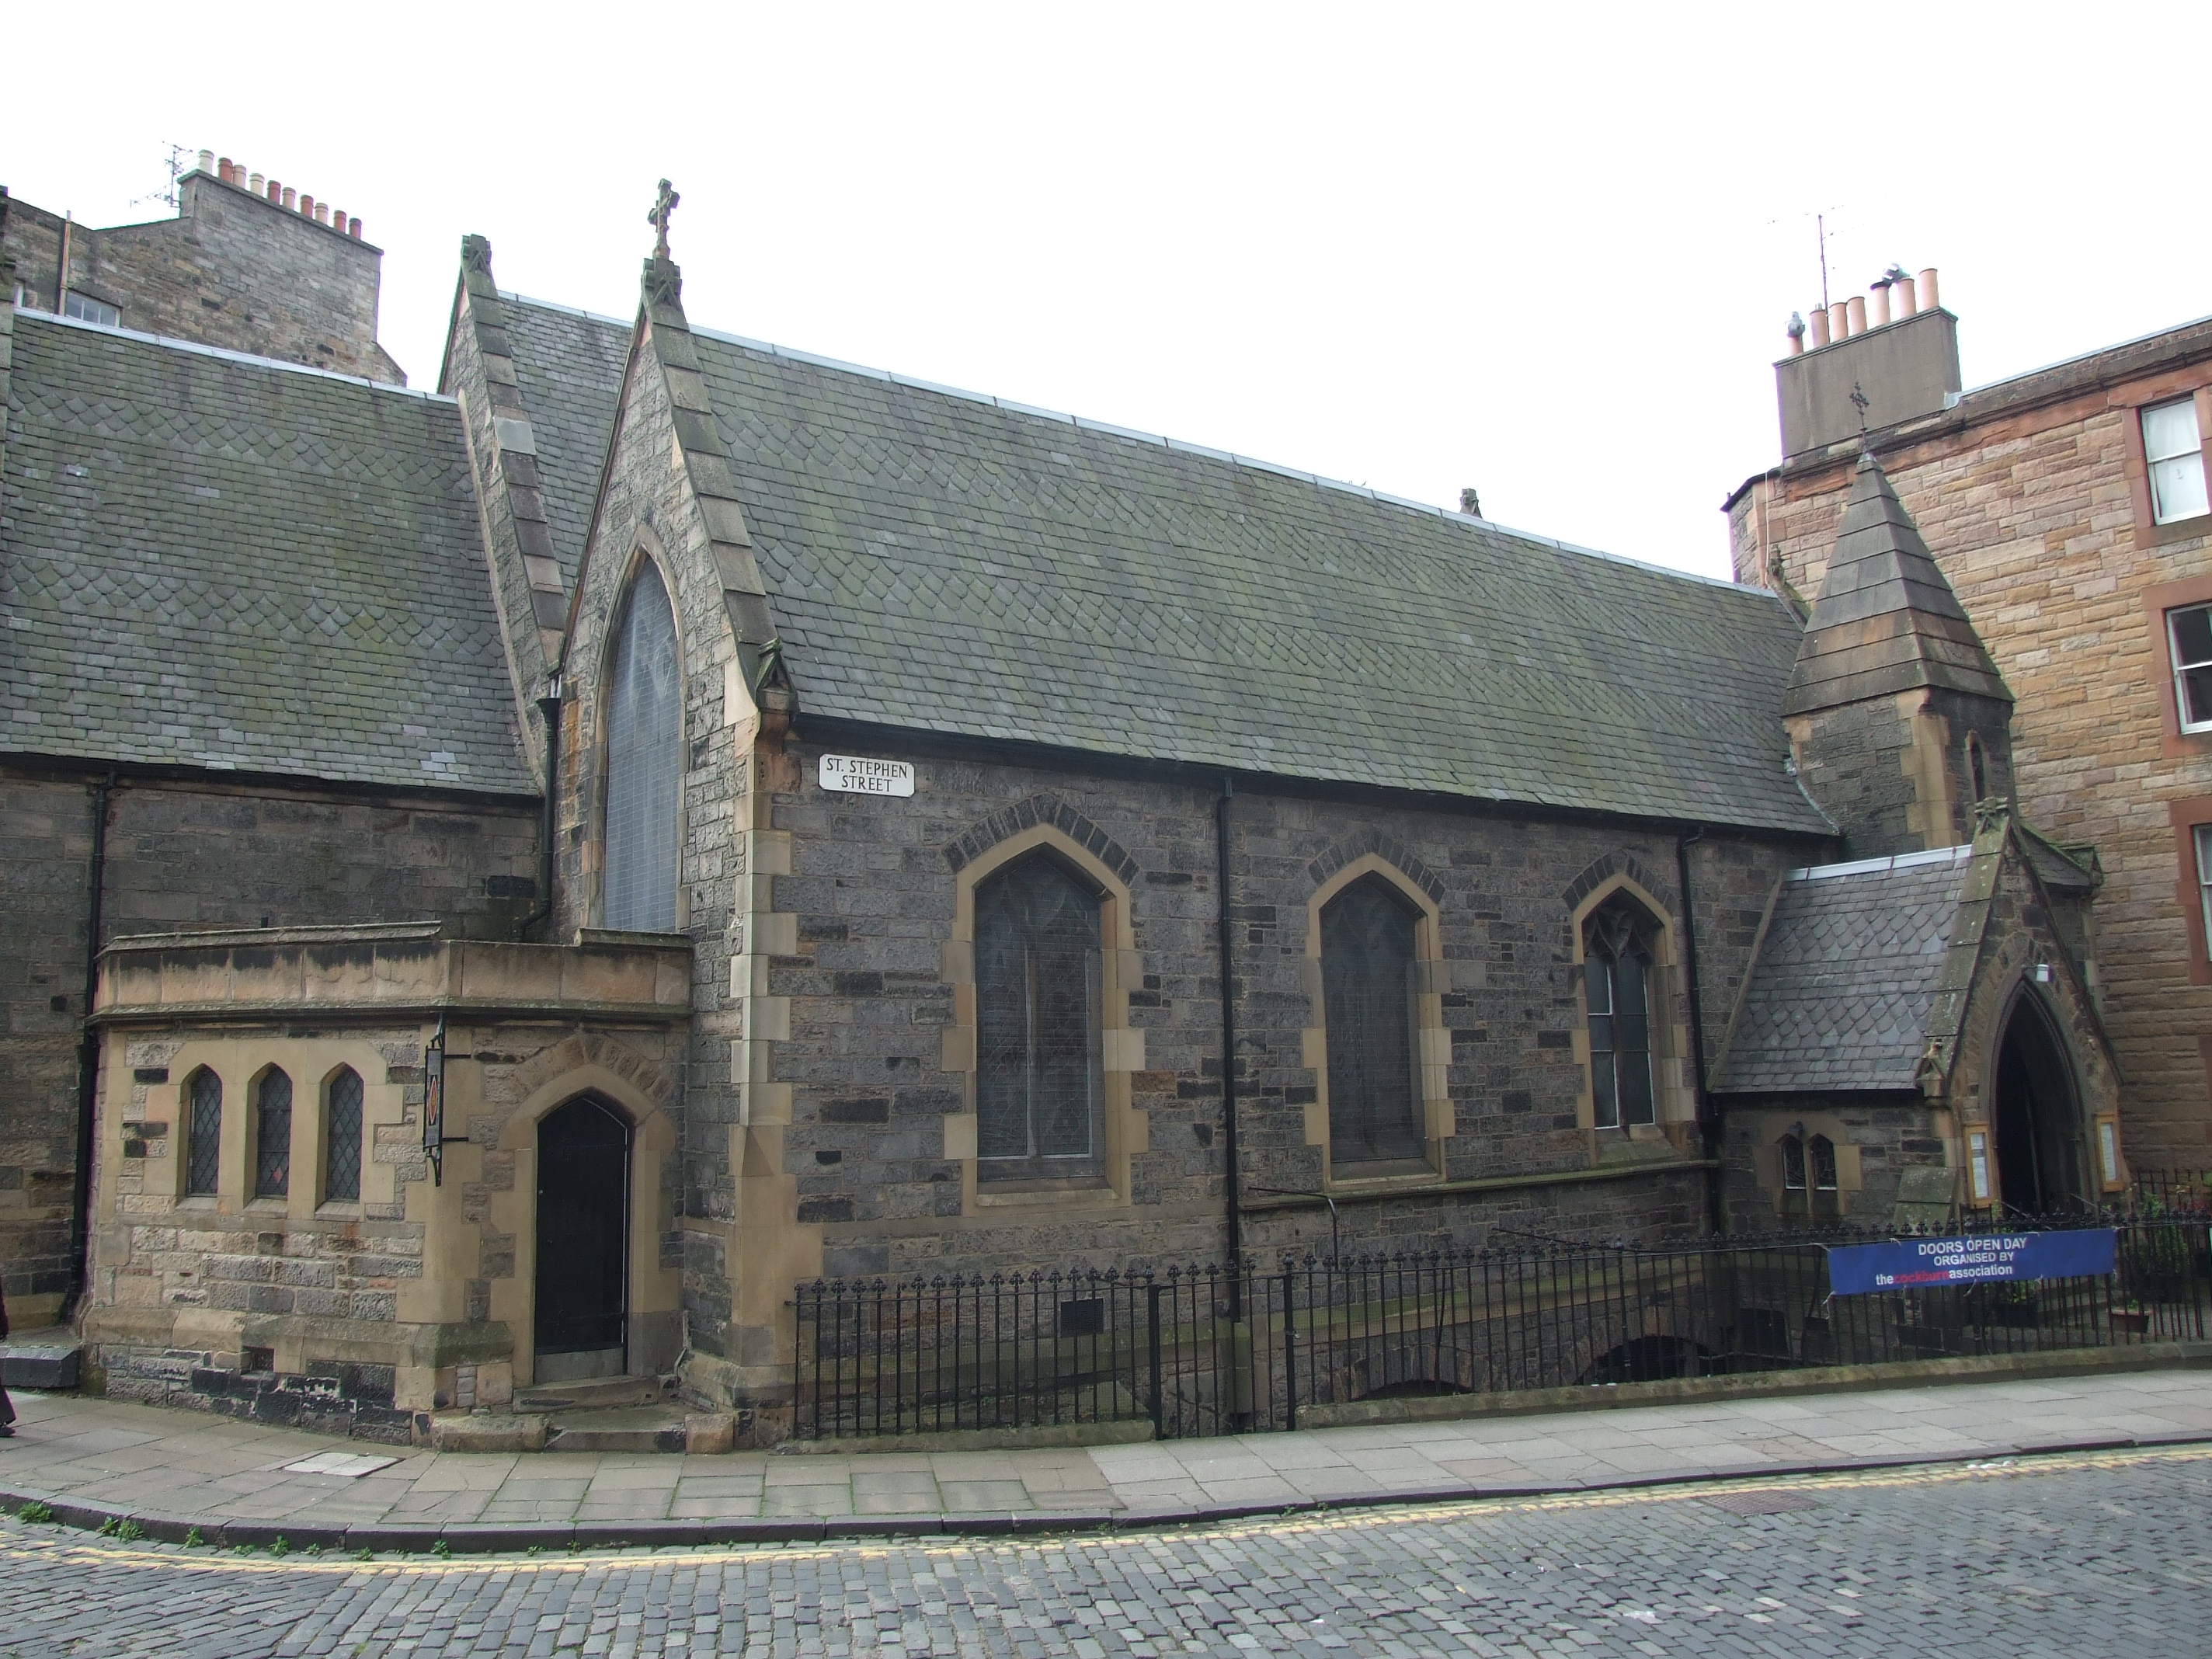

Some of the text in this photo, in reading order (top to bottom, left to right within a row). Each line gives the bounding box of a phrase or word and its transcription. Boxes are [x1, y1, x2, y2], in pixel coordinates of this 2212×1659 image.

[826, 757, 907, 778] ST. STEPHEN
[842, 774, 892, 792] STREET
[1918, 1237, 2027, 1255] DOORS OPEN DAY
[1933, 1251, 2014, 1266] ORGANISED BY
